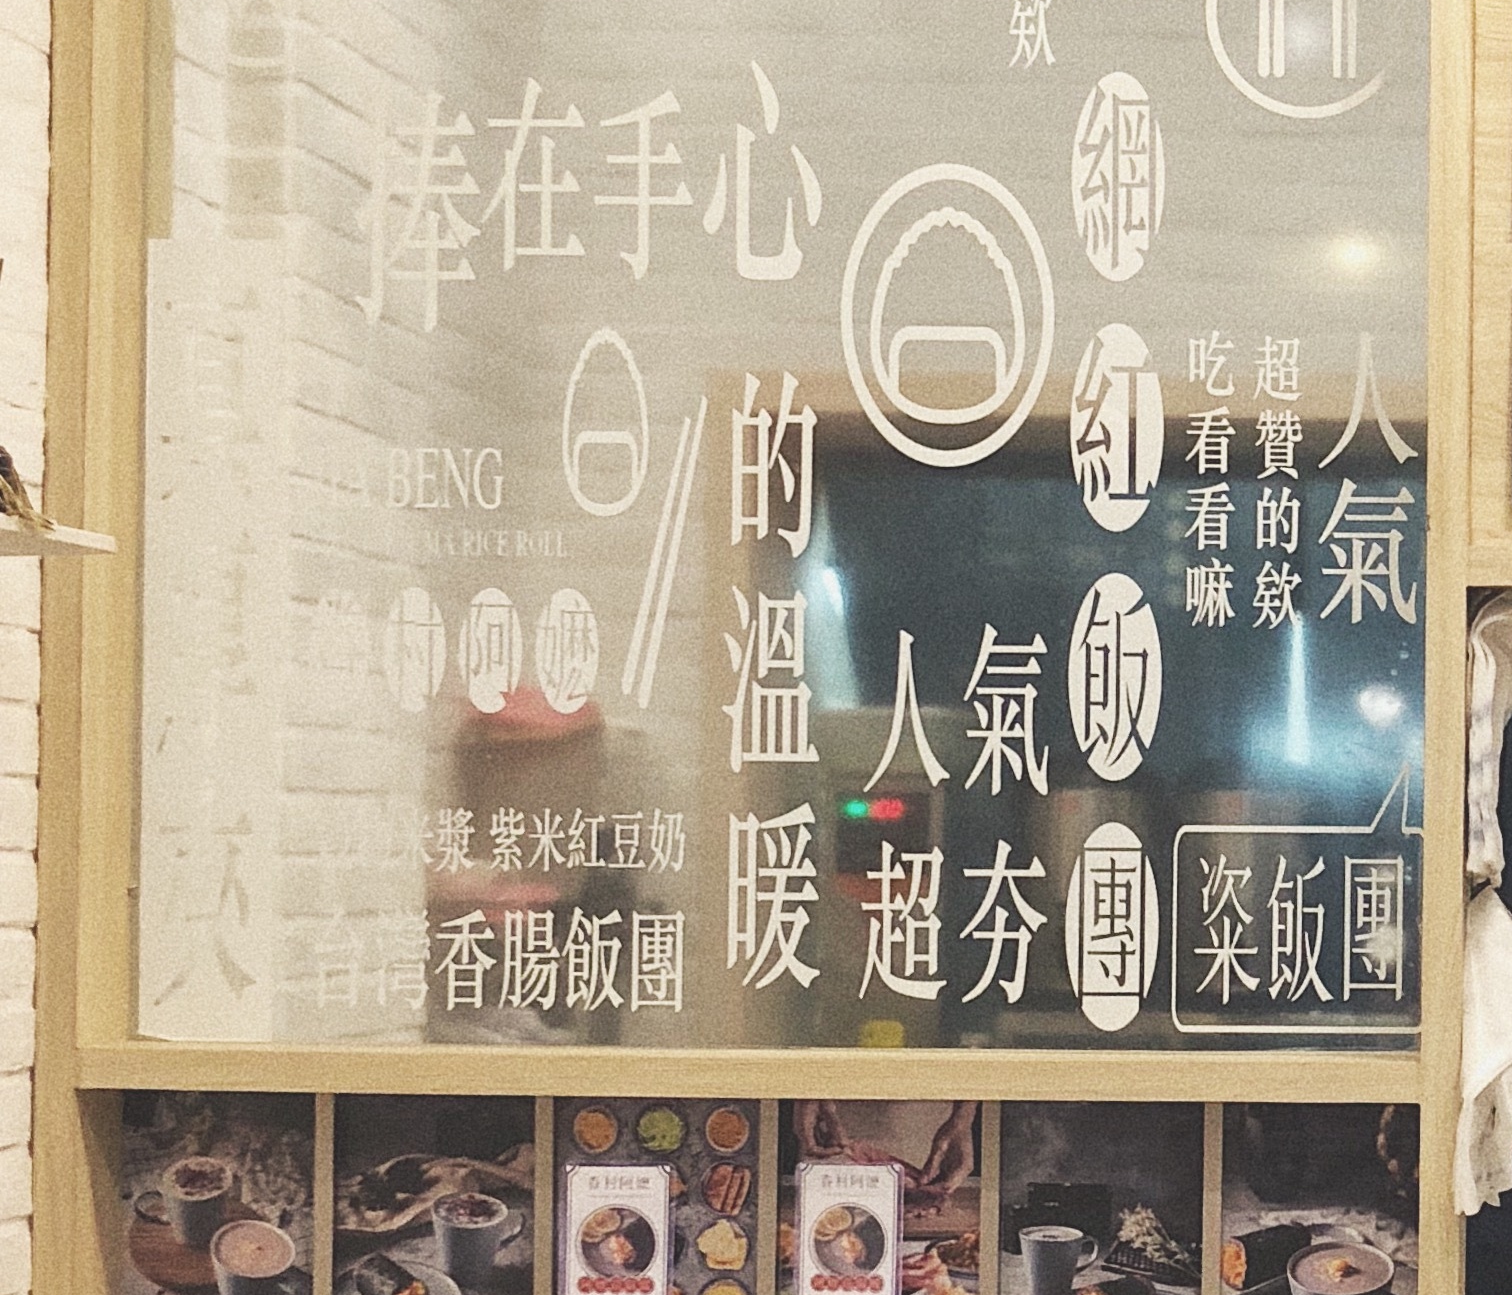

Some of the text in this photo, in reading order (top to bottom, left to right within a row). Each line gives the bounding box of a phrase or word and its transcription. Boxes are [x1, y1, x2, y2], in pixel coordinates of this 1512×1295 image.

[351, 60, 823, 333] 捧在手心
[1184, 331, 1237, 628] 吃看看嘛
[1318, 332, 1419, 625] 人氣
[864, 622, 1049, 796] 人氣
[859, 839, 1048, 1005] 超夯
